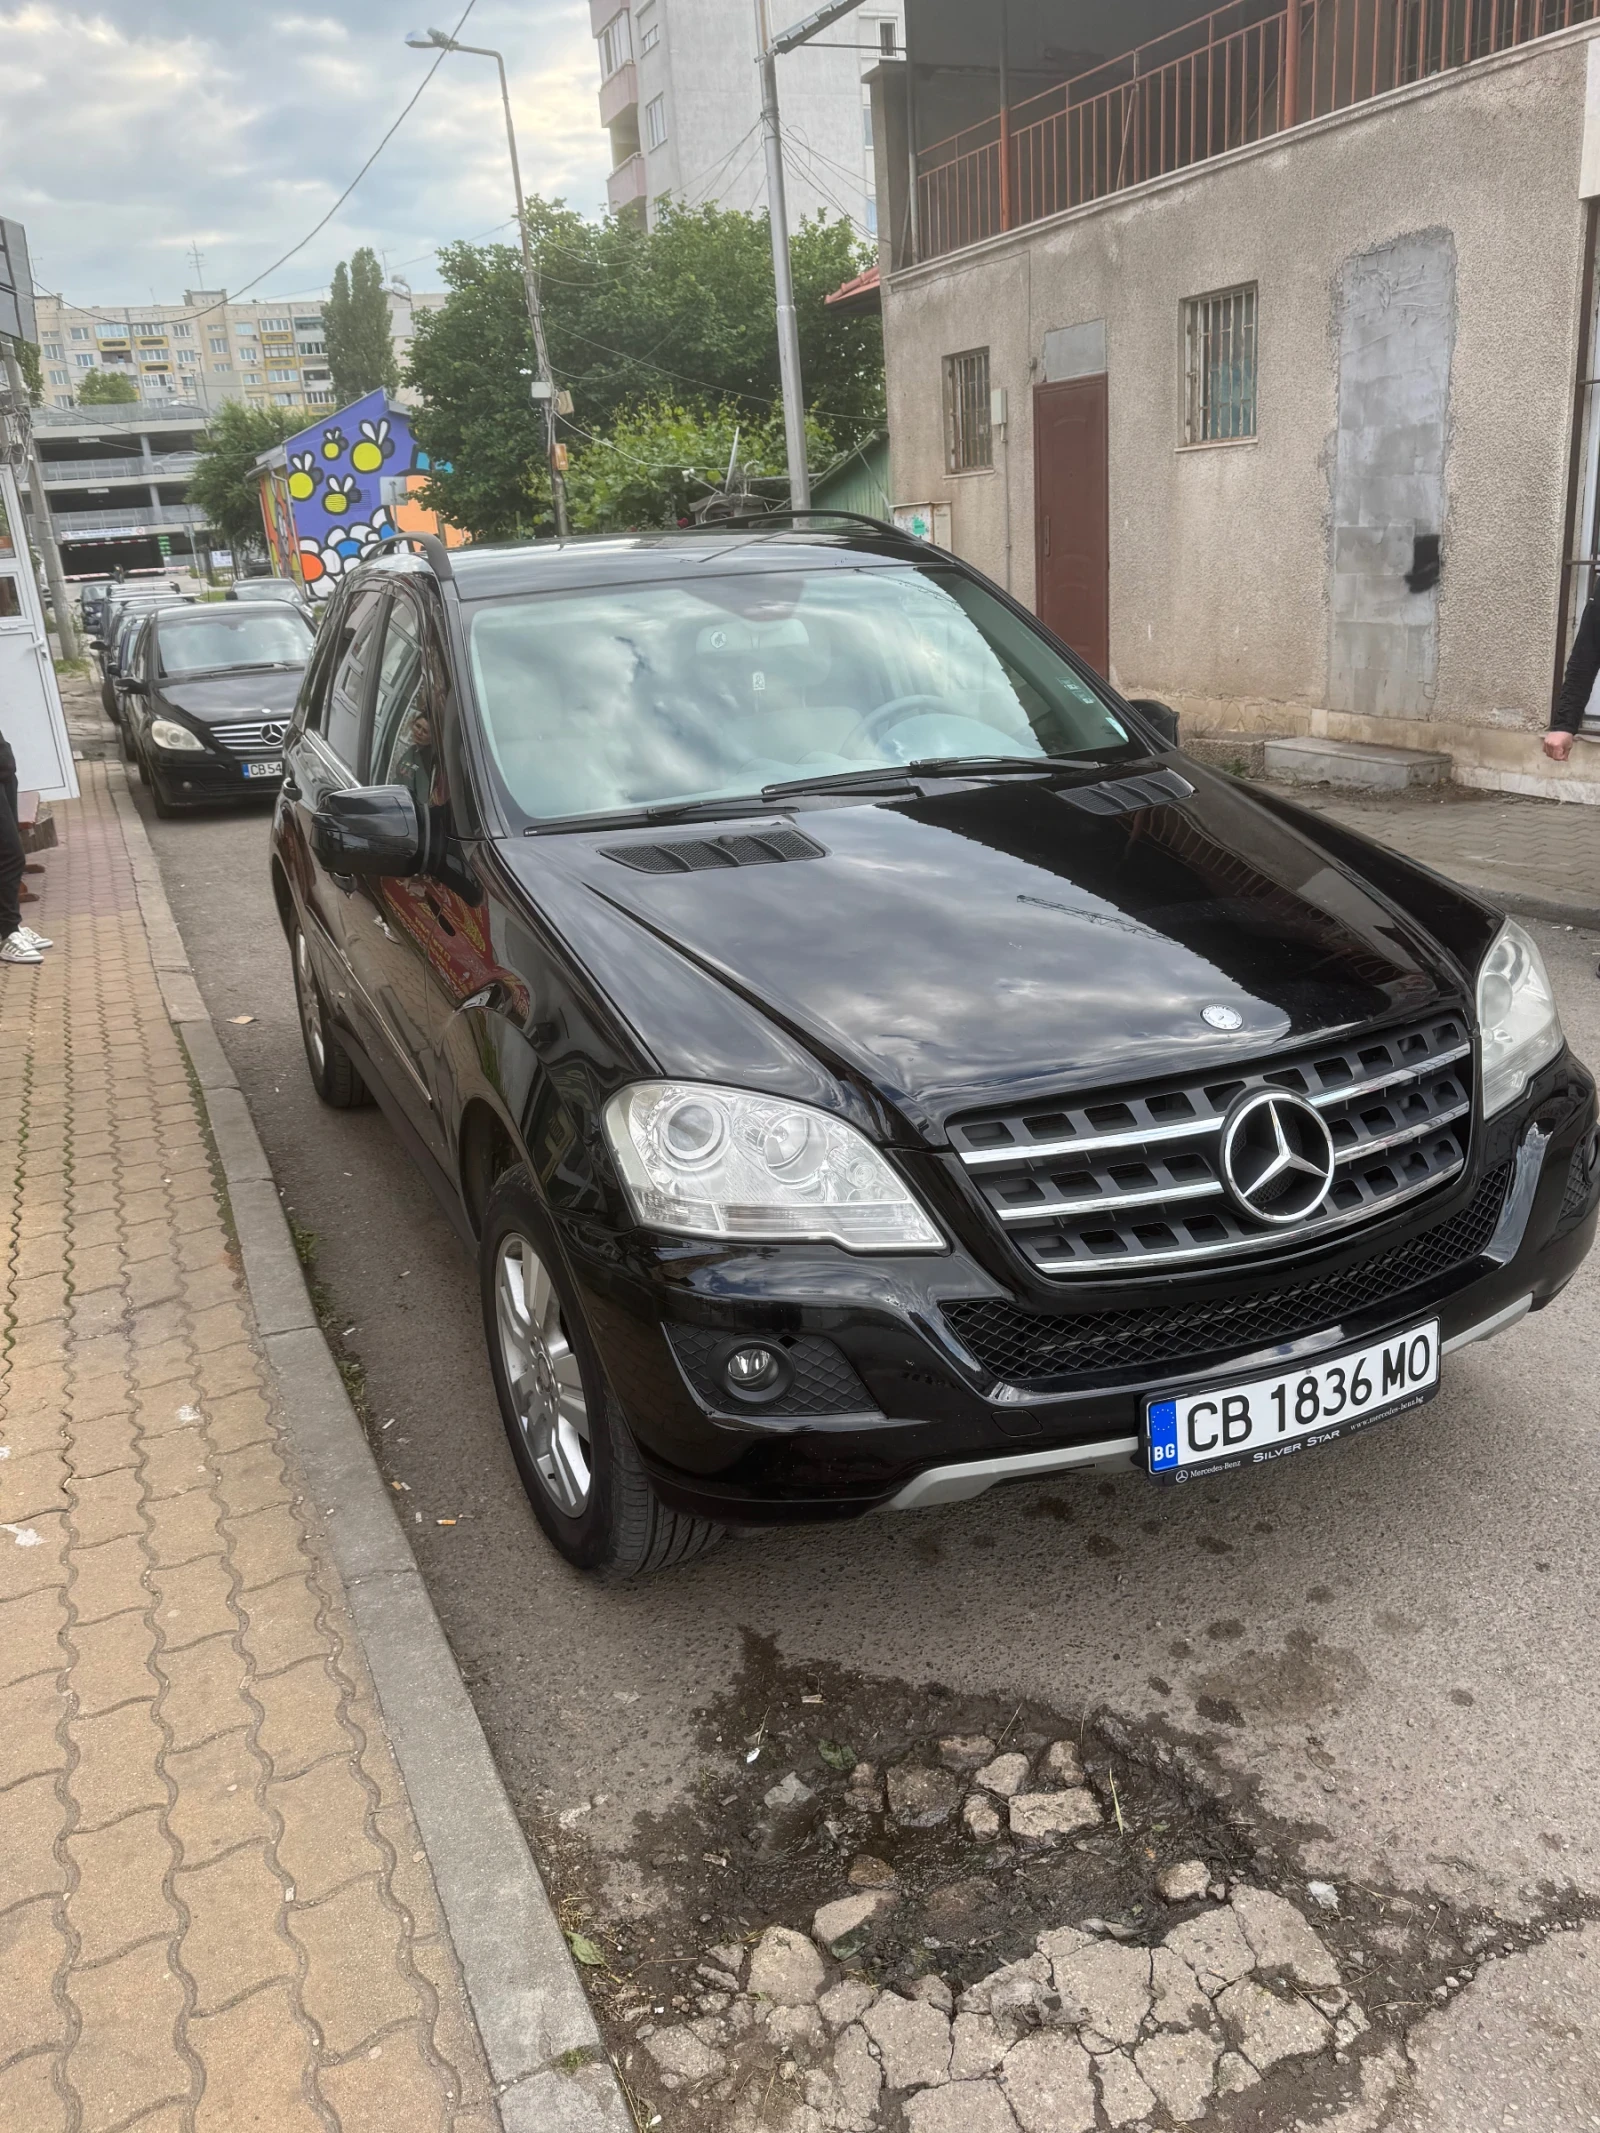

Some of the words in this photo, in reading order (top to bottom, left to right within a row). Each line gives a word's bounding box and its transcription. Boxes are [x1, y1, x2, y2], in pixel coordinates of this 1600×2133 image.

[251, 764, 266, 775] CB
[1187, 1394, 1253, 1453] CB
[1270, 1357, 1373, 1433] 1836
[1382, 1334, 1431, 1397] MO
[1154, 1443, 1176, 1462] BG
[1190, 1459, 1241, 1478] Mercedes-Benz
[1252, 1442, 1302, 1463] SILVER
[1306, 1428, 1340, 1447] STAR
[1350, 1395, 1424, 1431] www.mercedes-benz.bg
